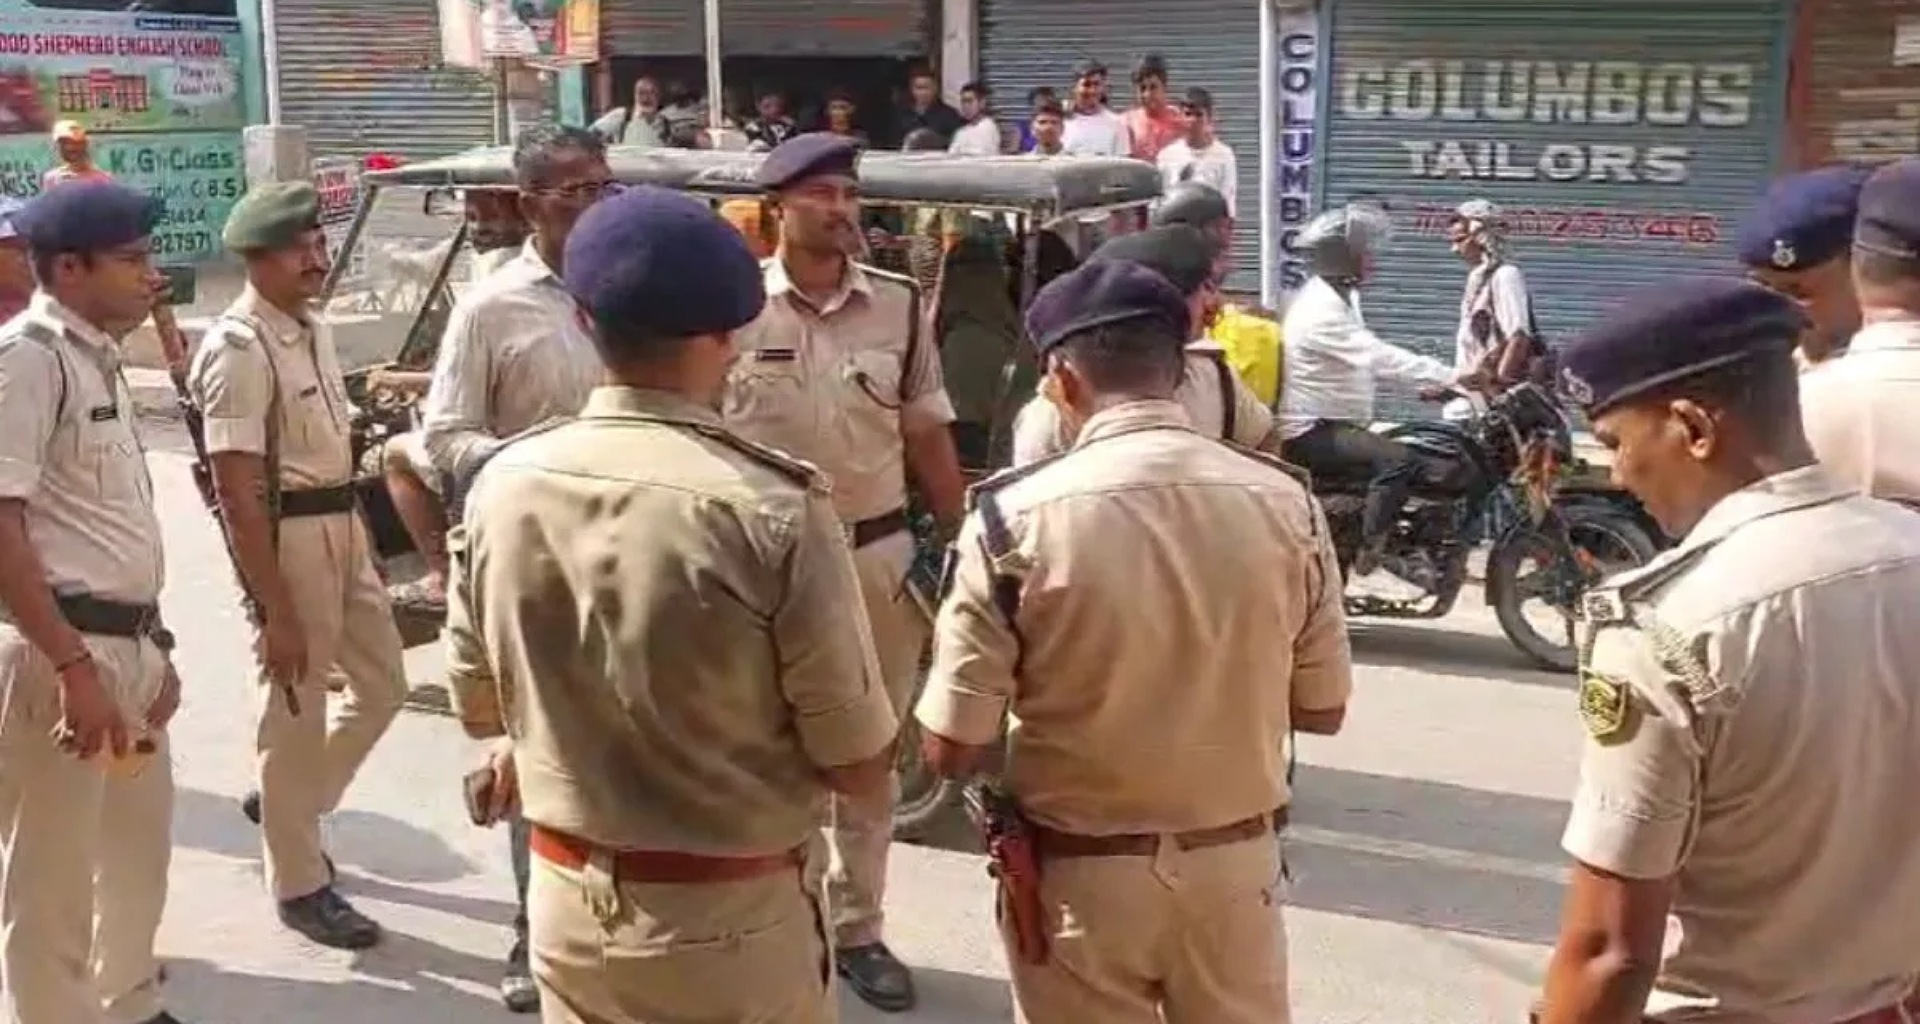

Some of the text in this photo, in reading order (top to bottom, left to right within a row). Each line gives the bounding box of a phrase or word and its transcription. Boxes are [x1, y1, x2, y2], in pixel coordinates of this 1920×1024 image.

[34, 34, 115, 55] SHEPHERD
[1341, 60, 1752, 127] COLUMBOS
[1401, 140, 1692, 183] TAILORS
